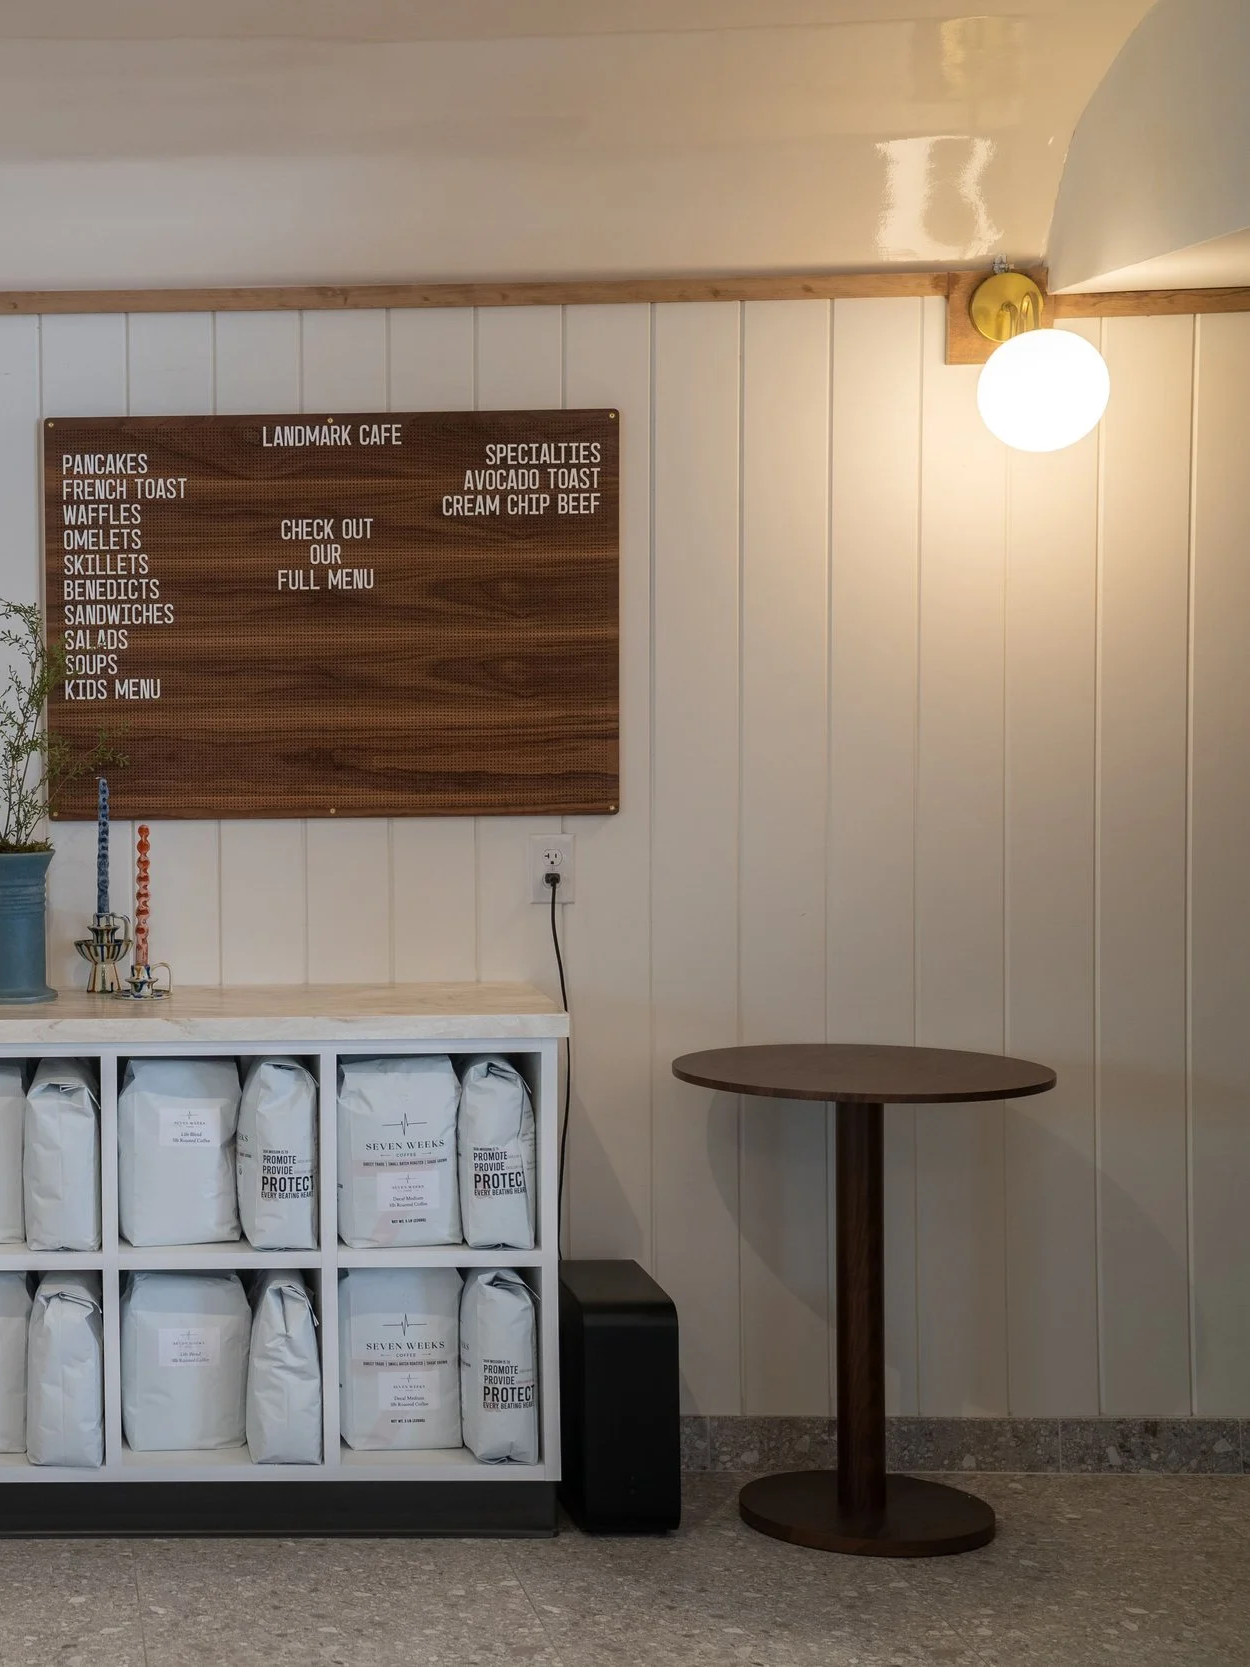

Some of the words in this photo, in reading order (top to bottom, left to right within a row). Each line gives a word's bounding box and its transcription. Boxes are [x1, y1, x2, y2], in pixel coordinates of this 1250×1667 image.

[263, 425, 351, 446] LANDMARK
[360, 425, 401, 445] CAFE
[486, 443, 600, 464] SPECIALTIES
[63, 454, 147, 474] PANCAKES
[63, 479, 126, 500] FRENCH
[135, 478, 187, 498] TOAST
[464, 469, 539, 490] AVOCADO
[548, 468, 600, 488] TOAST
[63, 504, 140, 525] WAFFLES
[443, 495, 499, 515] CREAM
[508, 494, 549, 514] CHIP
[559, 494, 600, 513] BEEF
[64, 529, 141, 549] OMELETS
[282, 519, 334, 539] CHECK
[343, 519, 373, 538] OUT
[311, 544, 341, 564] OUR
[64, 554, 148, 575] SKILLETS
[64, 579, 159, 600] BENEDICTS
[278, 570, 319, 590] FULL
[329, 569, 373, 589] MENU
[65, 604, 173, 625] SANDWICHES
[65, 630, 128, 649] SALADS
[66, 654, 117, 674] SOUPS
[65, 680, 107, 699] KIDS
[116, 679, 160, 699] MENU
[406, 1140, 444, 1149] WEEKS
[263, 1155, 297, 1164] PROMOTE
[474, 1152, 507, 1161] PROMOTE
[474, 1162, 505, 1171] PROVIDE
[263, 1165, 293, 1174] PROVIDE
[262, 1175, 313, 1192] PROTECT
[406, 1342, 445, 1350] WEEKS
[484, 1364, 518, 1374] PROMOTE
[484, 1375, 515, 1384] PROVIDE
[484, 1384, 534, 1402] PROTECT
